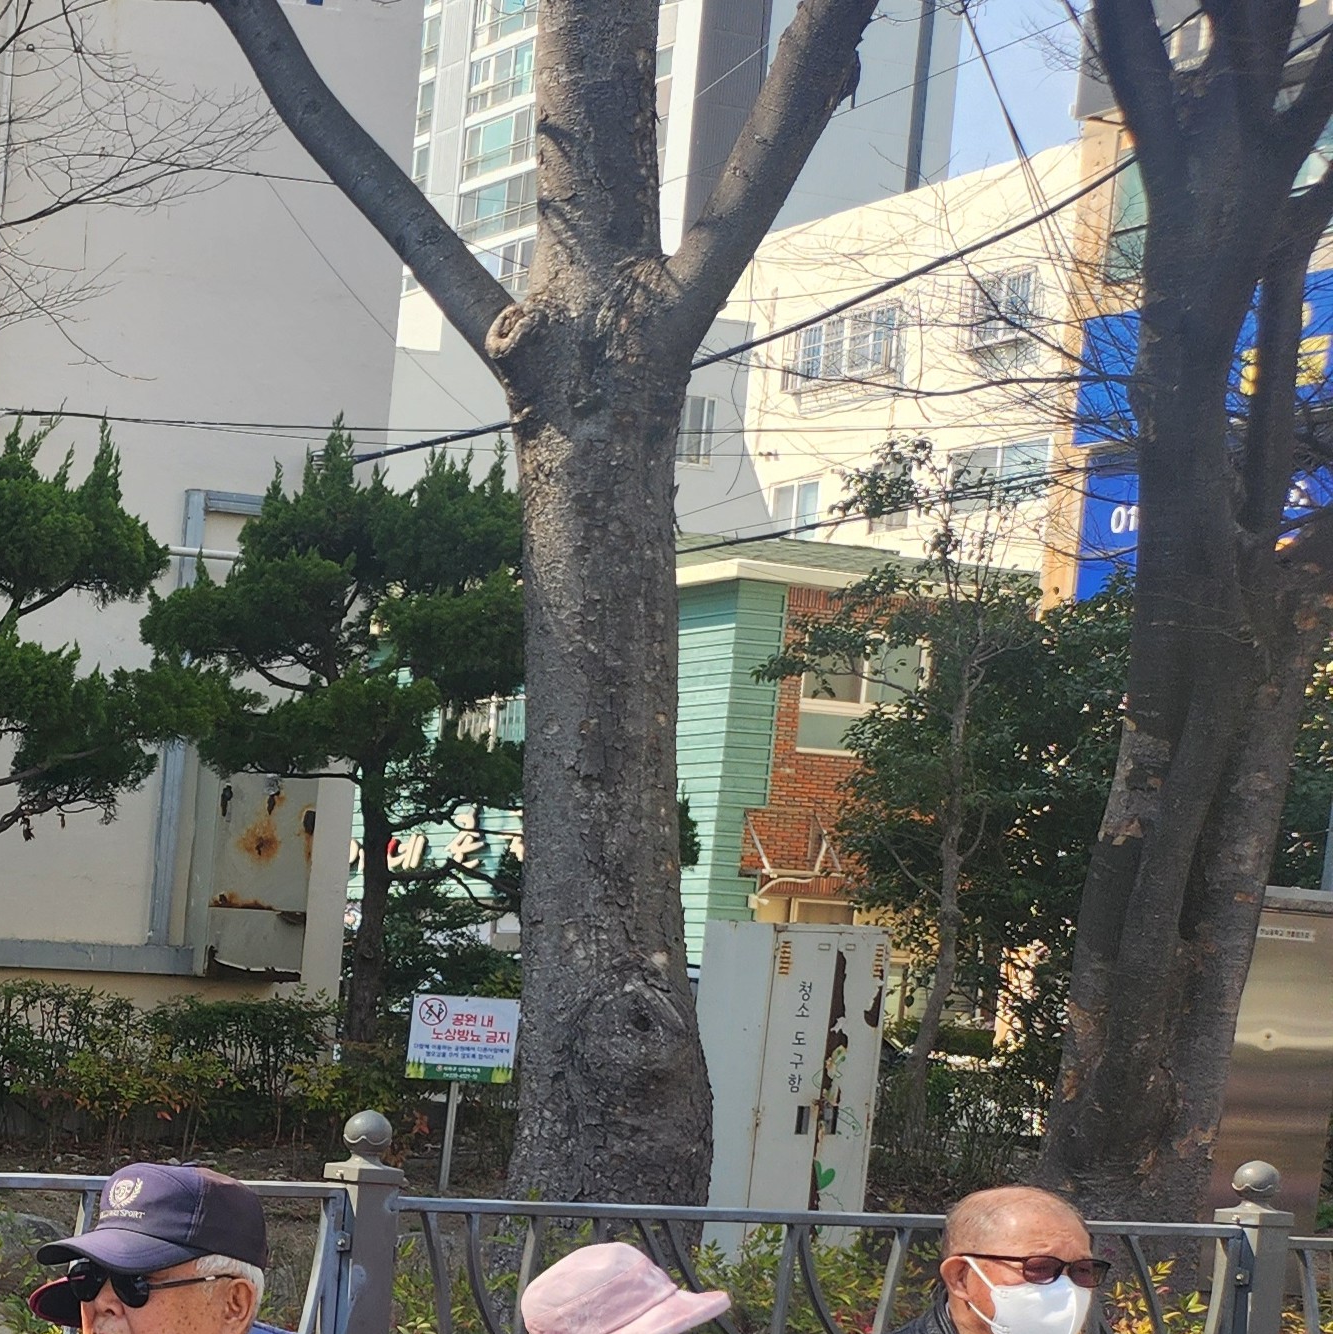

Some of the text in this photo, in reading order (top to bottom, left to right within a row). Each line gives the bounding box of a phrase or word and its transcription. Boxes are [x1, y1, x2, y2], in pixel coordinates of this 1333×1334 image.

[1111, 505, 1140, 534] 01
[452, 1013, 494, 1028] 공원 내
[431, 1028, 511, 1044] 노상방뇨 금지
[788, 981, 812, 1093] 청소 도구함
